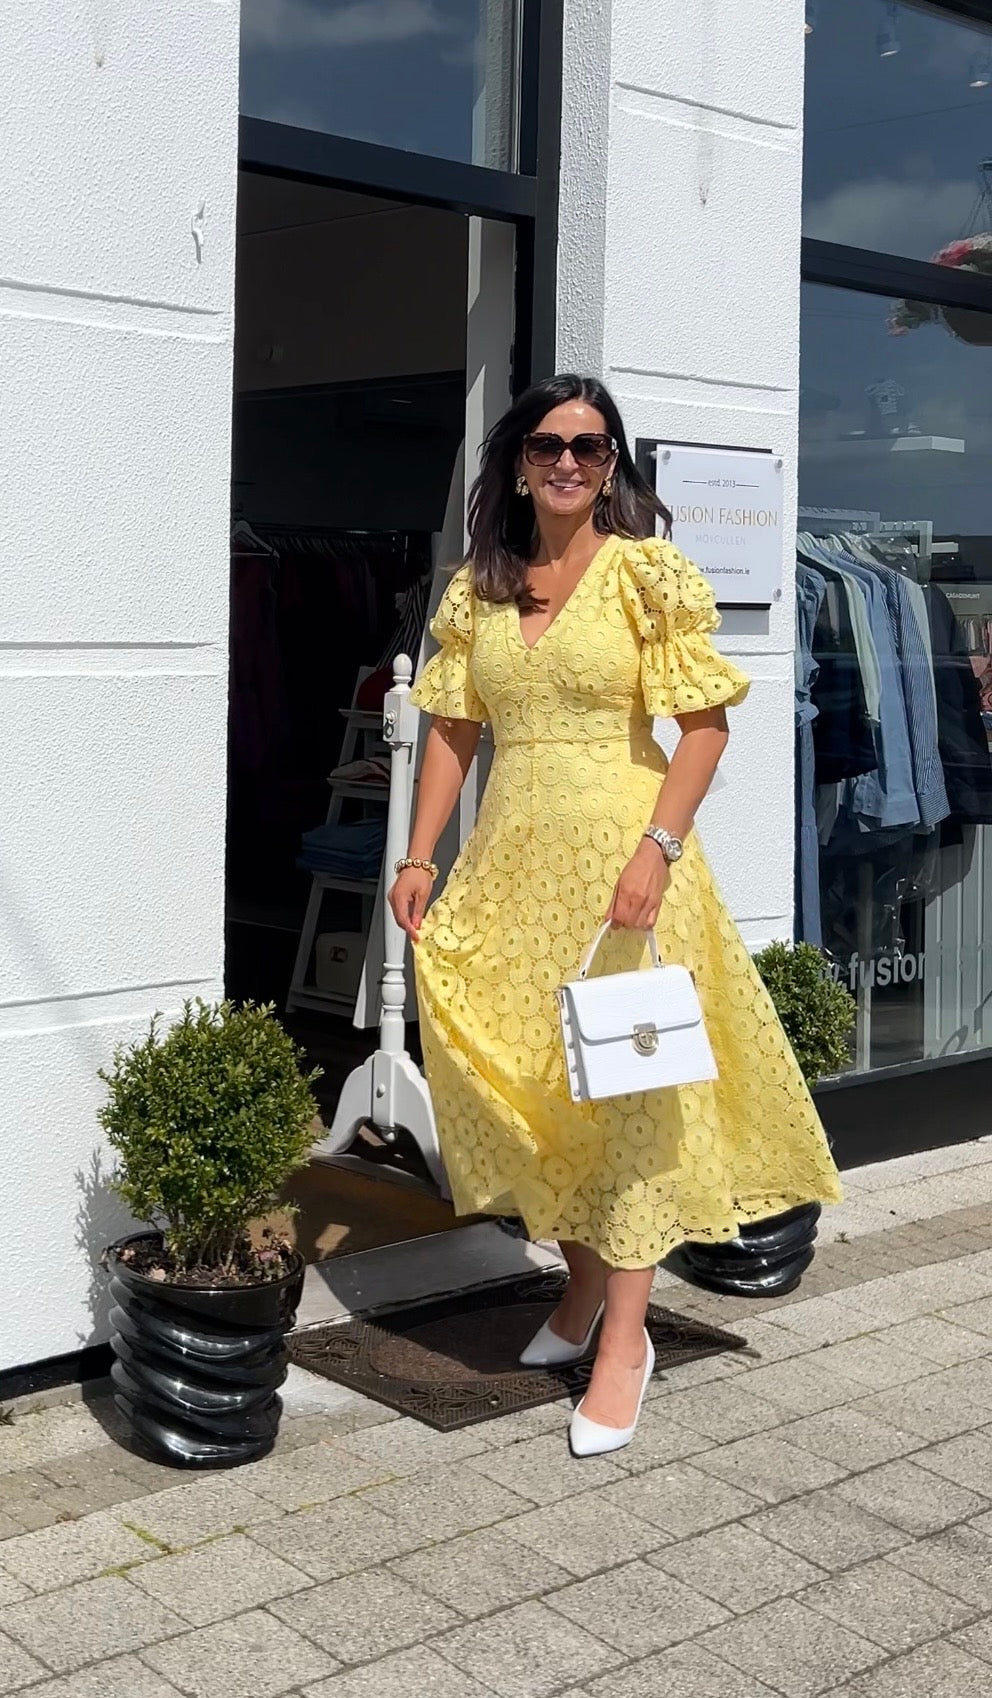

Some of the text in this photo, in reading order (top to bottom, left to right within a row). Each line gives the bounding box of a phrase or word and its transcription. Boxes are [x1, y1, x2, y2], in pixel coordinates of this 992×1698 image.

[722, 479, 736, 489] 2013
[664, 504, 778, 527] USION FASHION
[695, 534, 746, 546] MOYCULLEN
